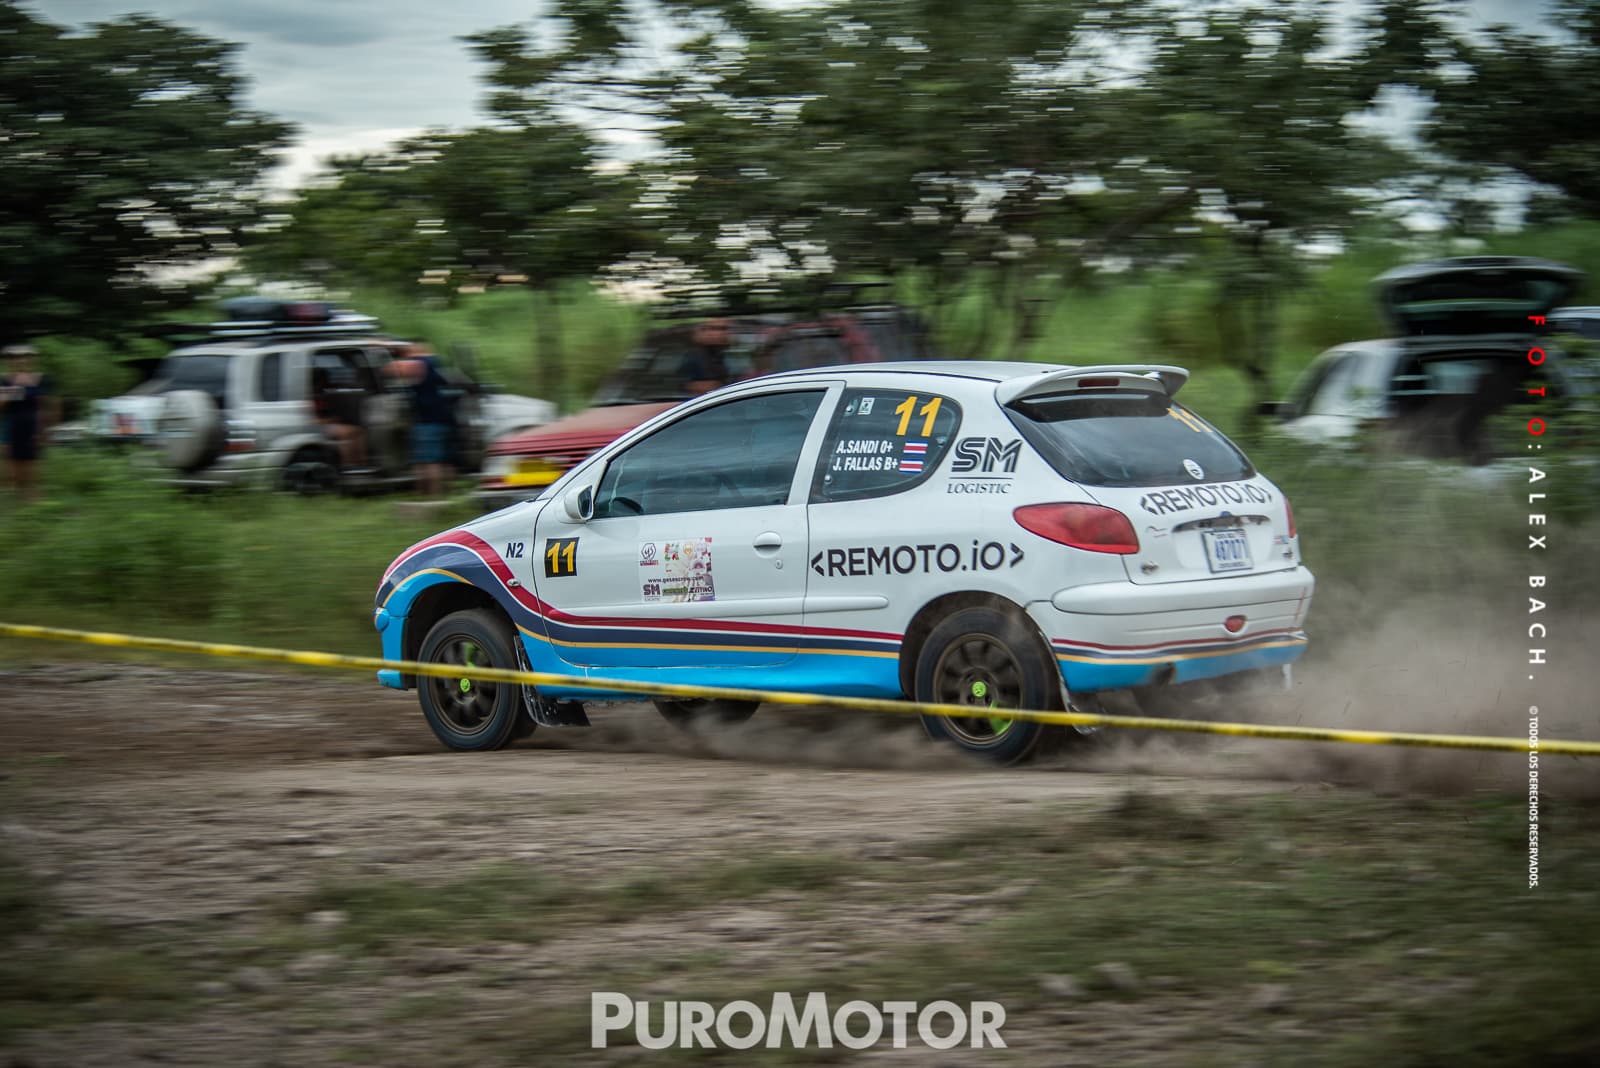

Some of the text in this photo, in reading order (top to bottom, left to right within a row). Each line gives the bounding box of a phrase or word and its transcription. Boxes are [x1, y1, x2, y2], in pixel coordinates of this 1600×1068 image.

[895, 396, 942, 437] 11
[836, 440, 879, 454] A.SANDI
[951, 437, 1023, 473] SM
[832, 457, 898, 471] J. FALLAS B+
[947, 483, 1012, 494] LOGISTIC
[506, 542, 524, 558] N2
[547, 541, 576, 573] 11
[643, 584, 660, 595] SM
